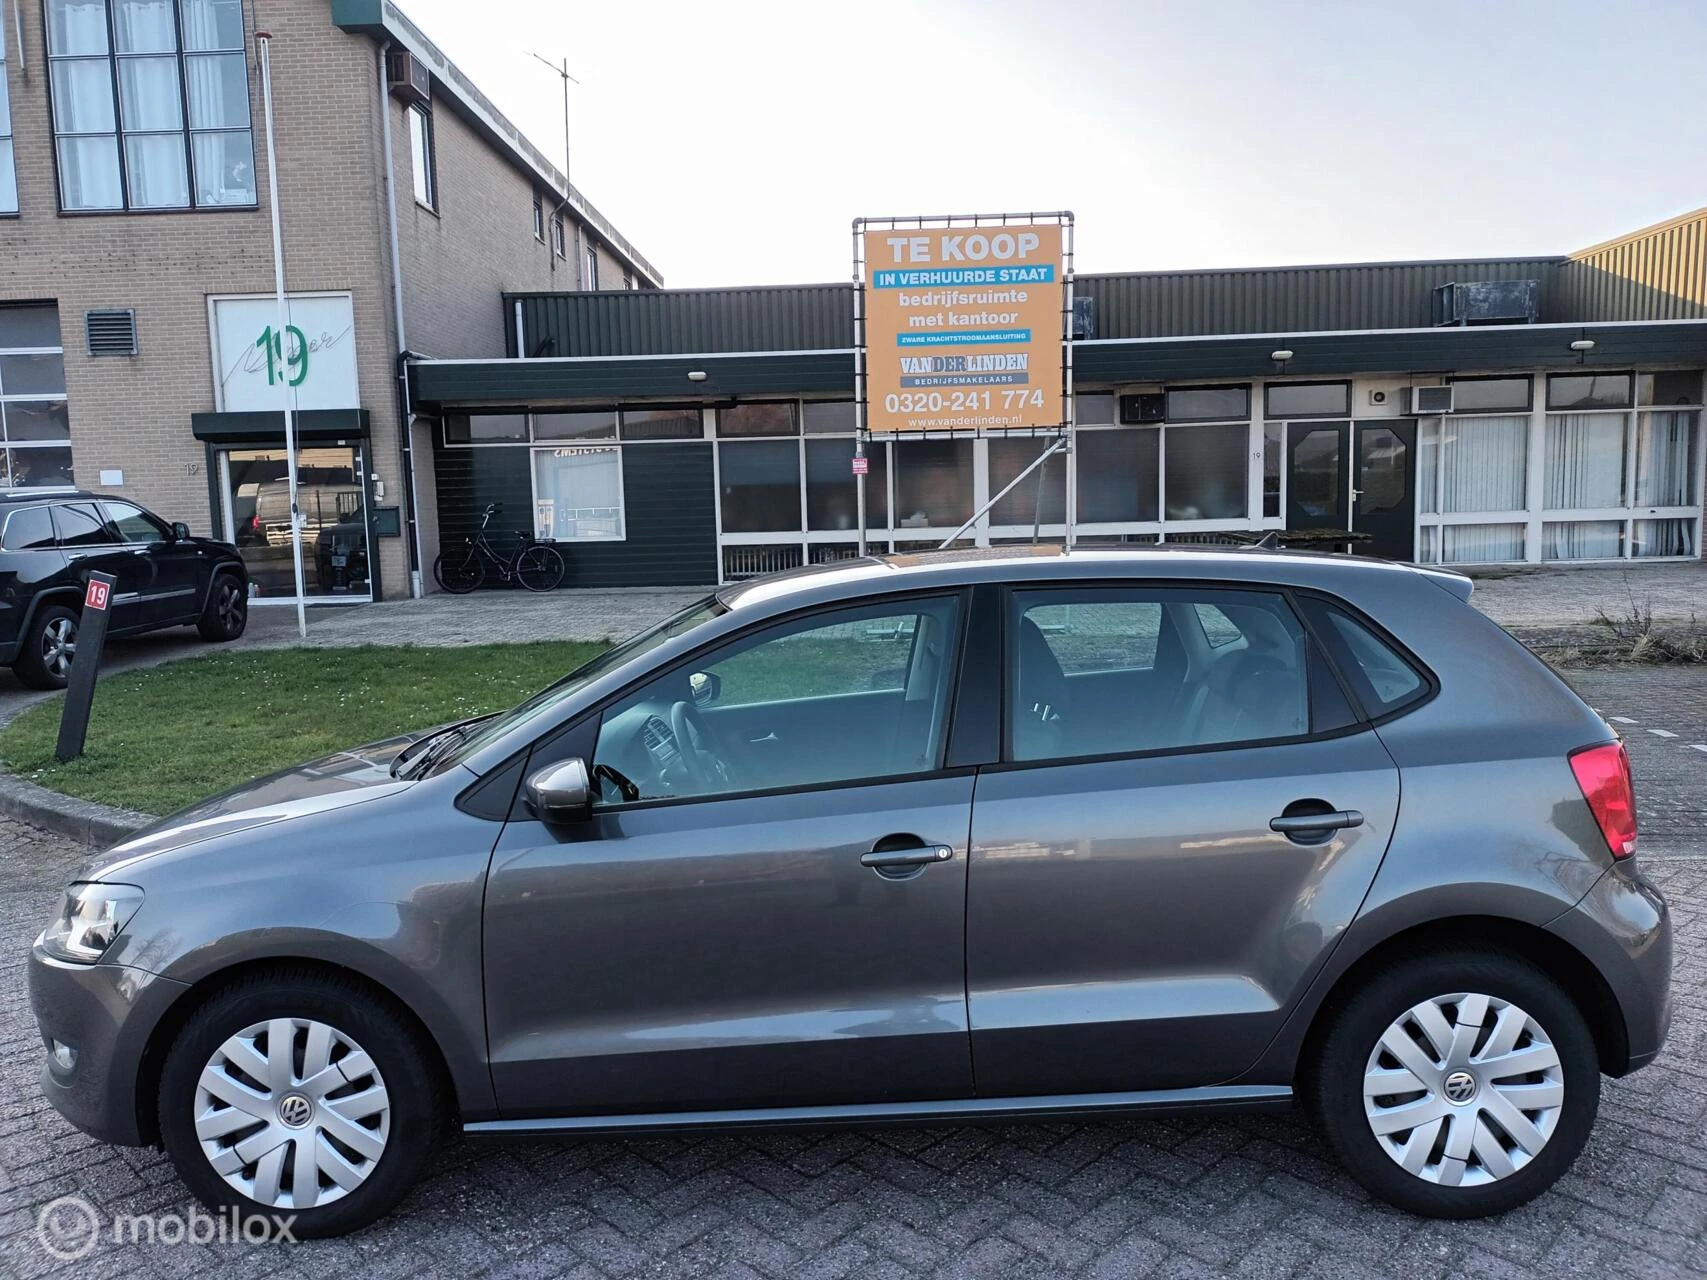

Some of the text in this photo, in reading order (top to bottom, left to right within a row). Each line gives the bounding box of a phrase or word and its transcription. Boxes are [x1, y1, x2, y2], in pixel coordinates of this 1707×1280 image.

[887, 232, 1040, 263] TE KOOP
[880, 268, 1048, 286] IN VERHUURDE STAAT
[899, 290, 1029, 308] bedrijfsruimte
[909, 311, 1019, 327] met kantoor
[902, 336, 926, 344] ZWARE
[256, 324, 309, 387] 19
[914, 375, 1014, 386] BEDRIJFSMAKELAARS
[885, 389, 1045, 413] 0320-241 774
[908, 415, 1023, 427] www.vanderlinden.nl
[184, 463, 198, 477] 19
[91, 585, 106, 605] 19
